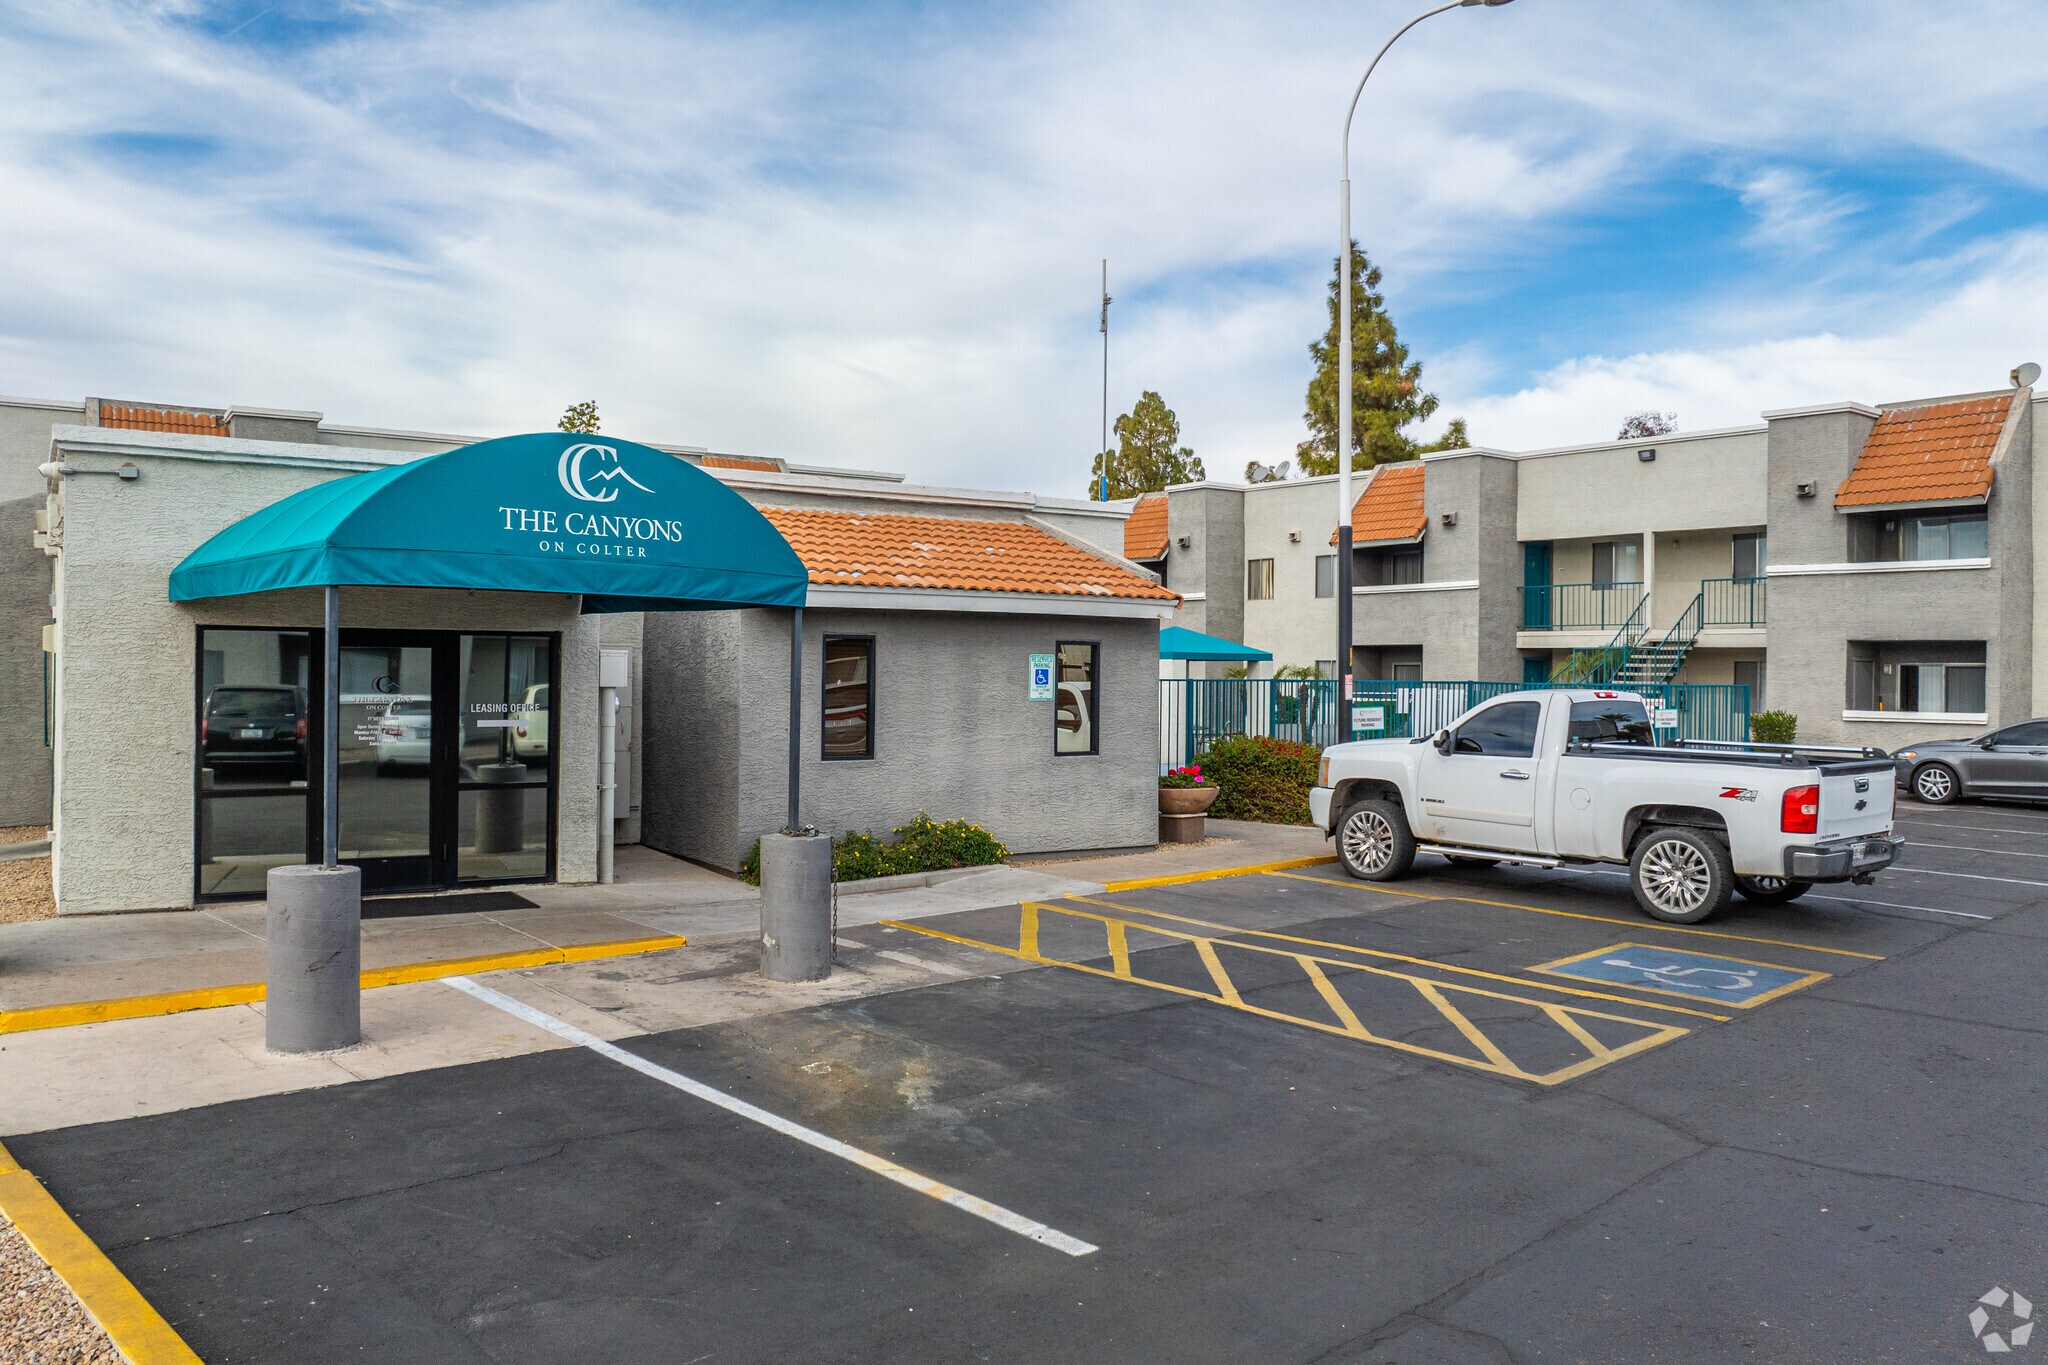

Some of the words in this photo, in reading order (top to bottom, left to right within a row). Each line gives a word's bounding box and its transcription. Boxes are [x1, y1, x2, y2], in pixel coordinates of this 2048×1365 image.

[499, 507, 558, 533] THE
[565, 513, 682, 542] CANYONS
[539, 540, 564, 552] ON
[577, 543, 647, 557] COLTER
[470, 703, 508, 713] LEASING
[510, 703, 540, 713] OFFICE
